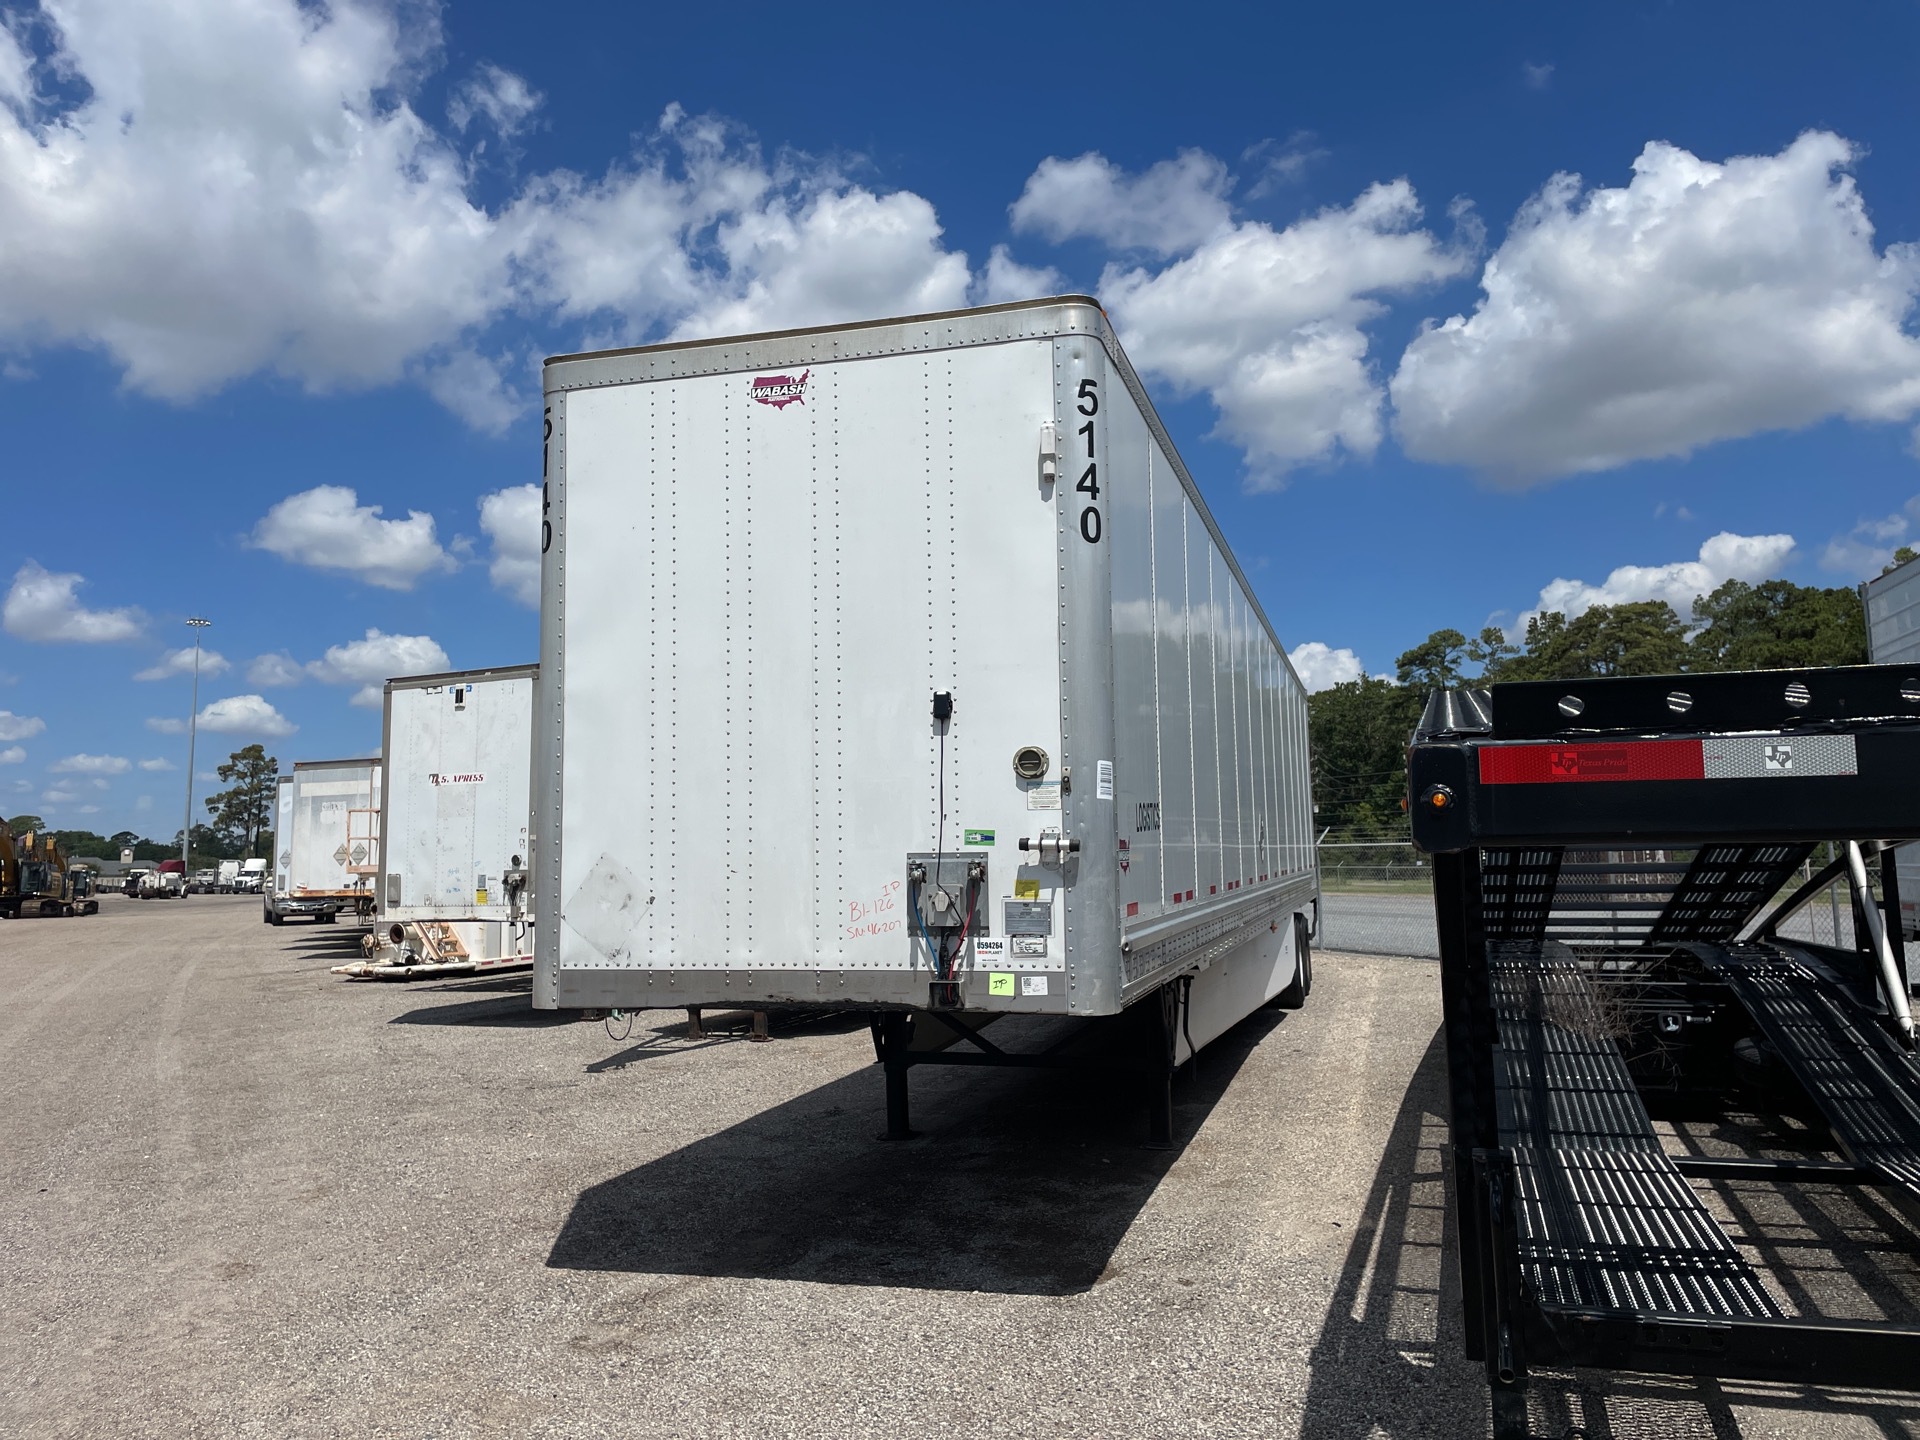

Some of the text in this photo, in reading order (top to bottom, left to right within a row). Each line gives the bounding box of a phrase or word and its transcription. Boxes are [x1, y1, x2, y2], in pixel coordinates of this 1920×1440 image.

[751, 383, 807, 398] WABASH
[1076, 379, 1101, 543] 5140
[1579, 759, 1601, 767] Texas
[453, 774, 484, 783] XPRESS
